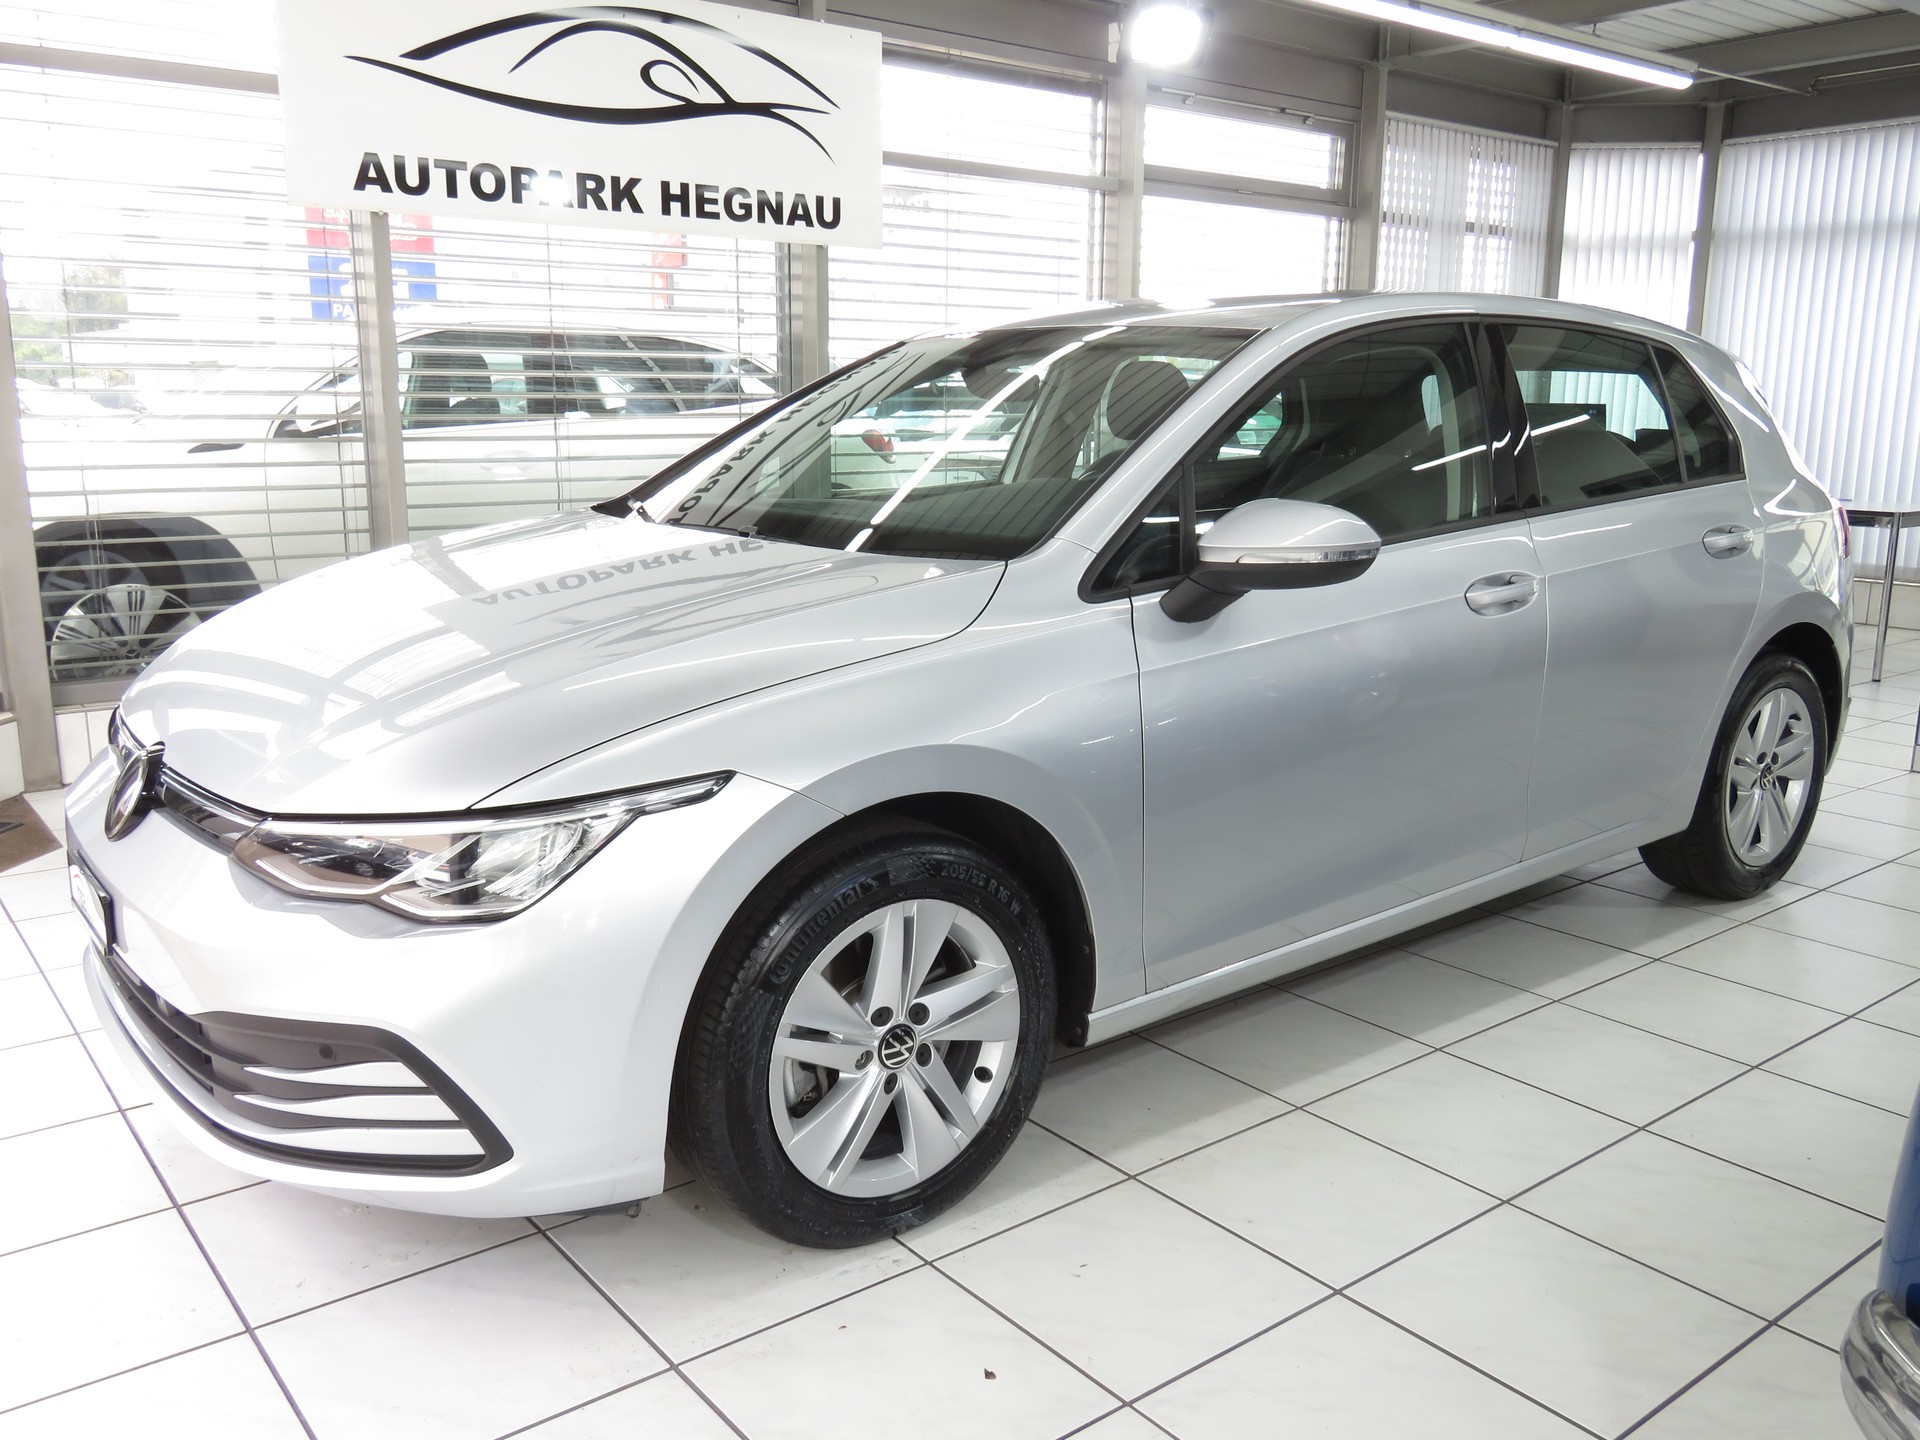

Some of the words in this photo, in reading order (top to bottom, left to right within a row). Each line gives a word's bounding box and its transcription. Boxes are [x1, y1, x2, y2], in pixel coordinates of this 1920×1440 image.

[660, 180, 841, 230] HEGNAU
[941, 862, 987, 887] 205/55
[987, 878, 998, 894] R
[997, 886, 1010, 903] 16
